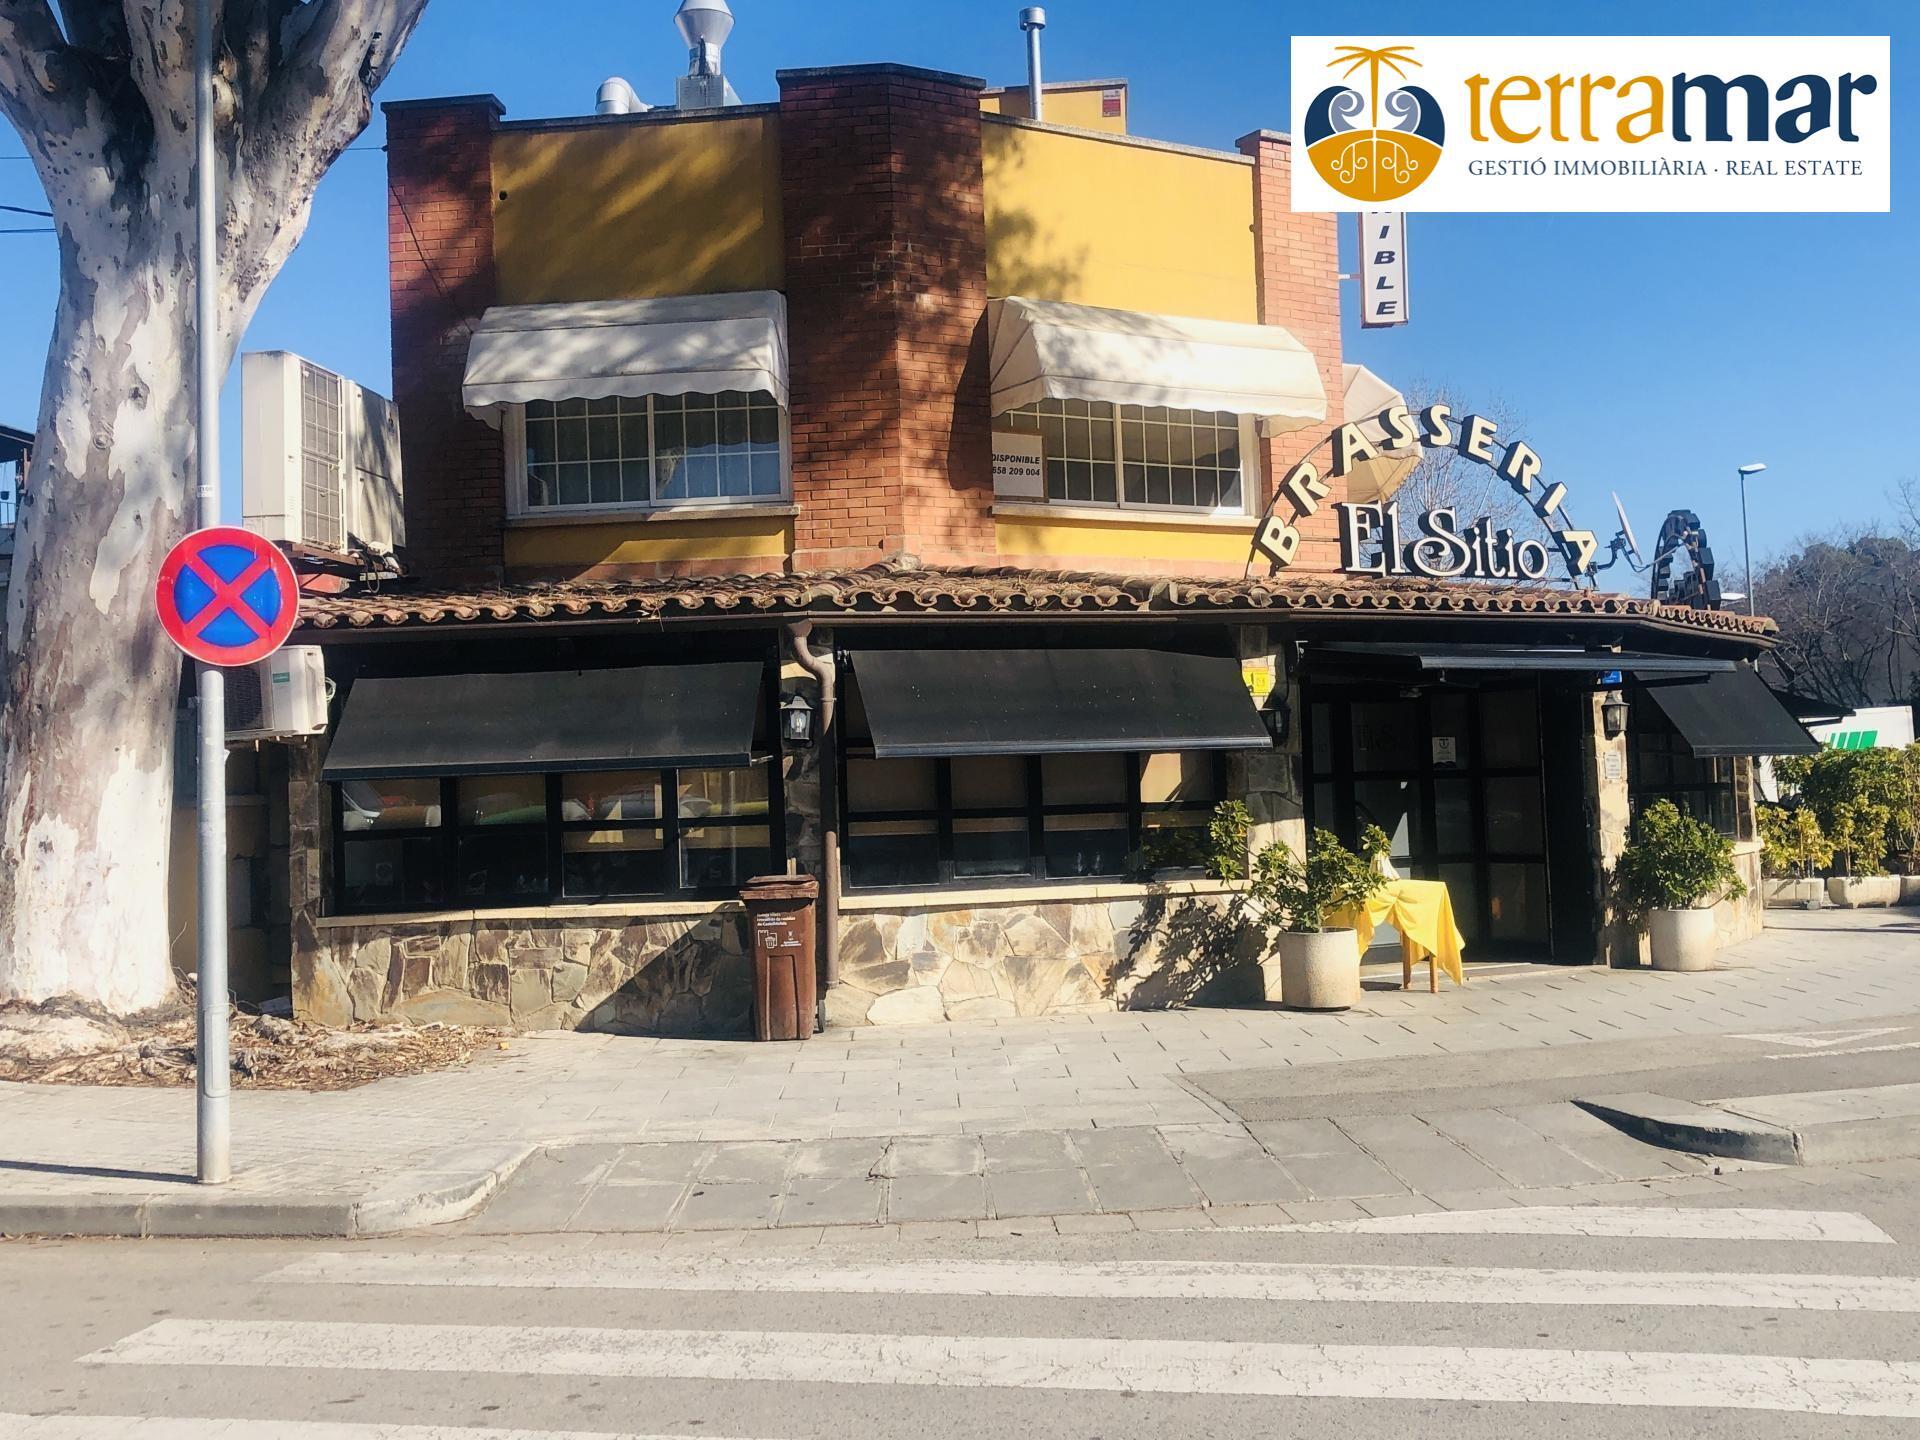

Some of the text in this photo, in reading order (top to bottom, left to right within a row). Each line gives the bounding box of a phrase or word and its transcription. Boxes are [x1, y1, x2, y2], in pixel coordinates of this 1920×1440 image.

[1373, 212, 1398, 316] IBLE
[992, 454, 1040, 464] DISPONIBLE
[1009, 467, 1023, 475] 209
[1025, 468, 1040, 476] 004
[1253, 404, 1599, 576] BRASSERIA
[1336, 500, 1550, 579] El Sitio
